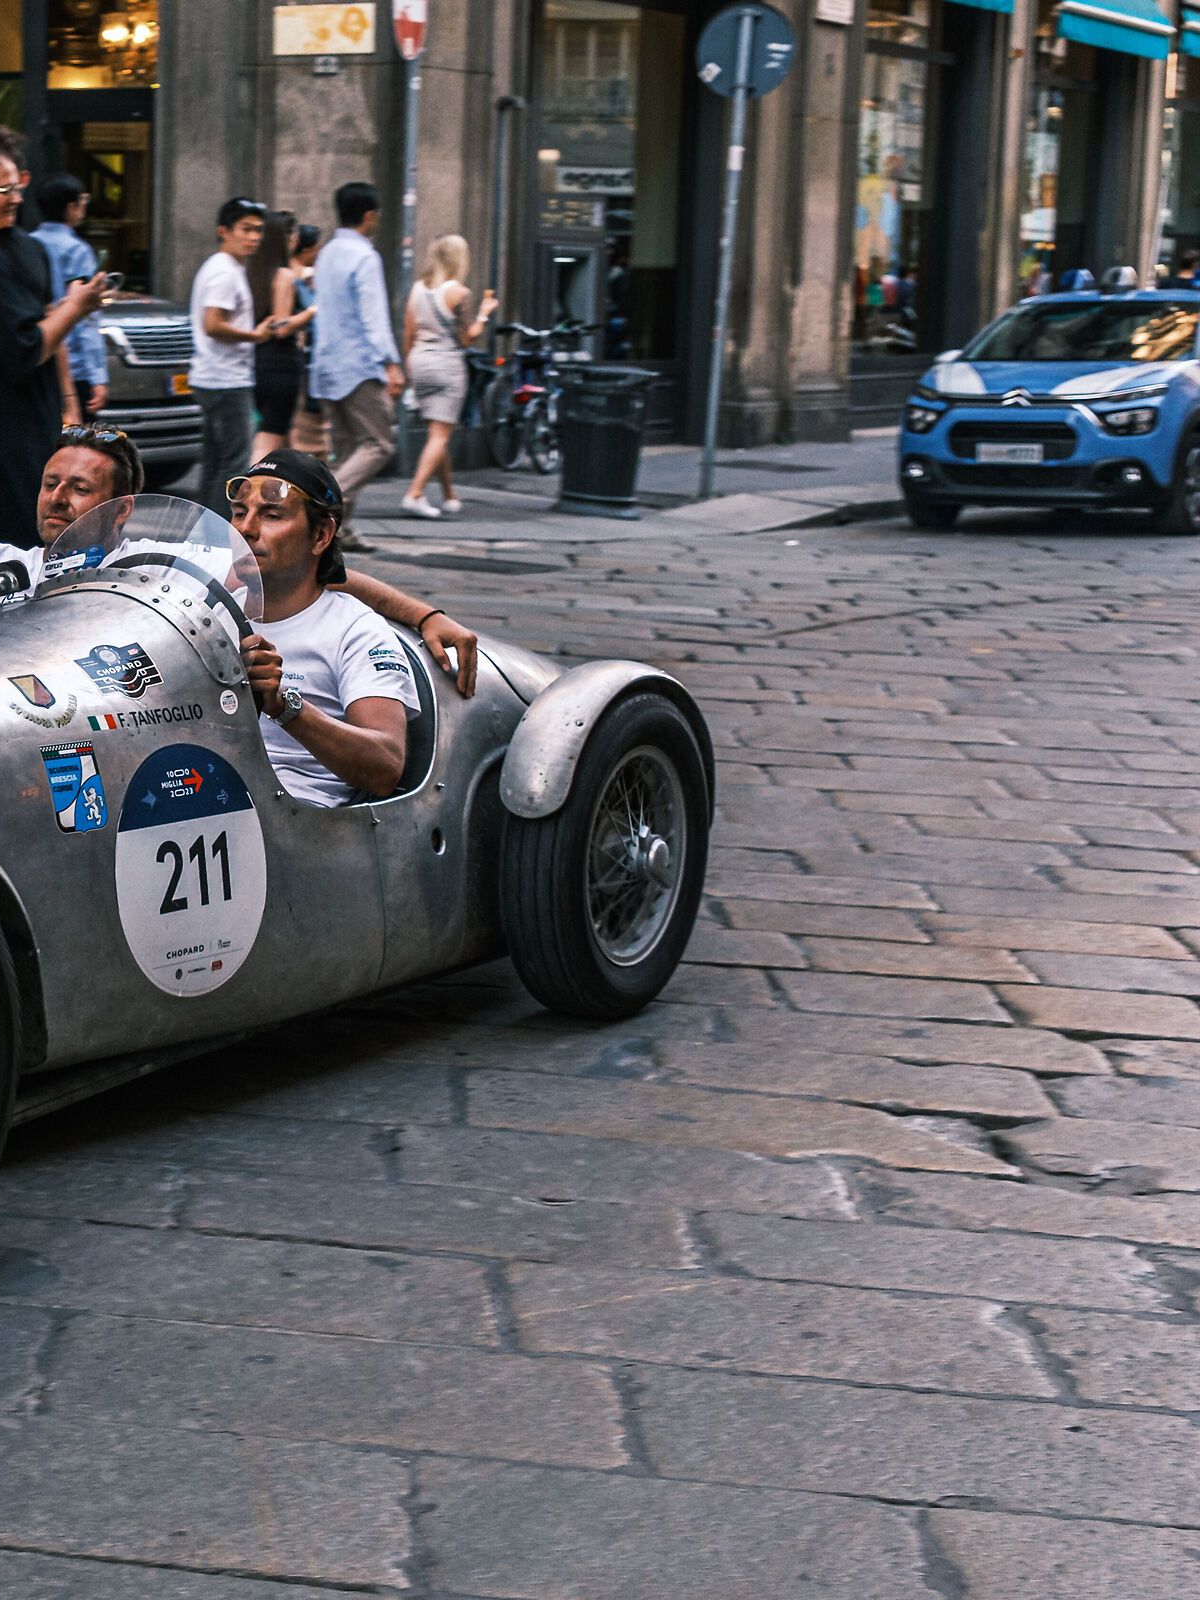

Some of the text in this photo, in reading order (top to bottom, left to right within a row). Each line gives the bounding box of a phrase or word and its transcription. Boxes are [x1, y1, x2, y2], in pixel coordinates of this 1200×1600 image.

[96, 660, 142, 677] CHOPARD
[116, 703, 204, 728] F. TANFOGLIO
[48, 764, 80, 775] SCUDERIA
[166, 768, 190, 778] 1000
[50, 774, 78, 784] BRESCIA
[161, 779, 183, 789] MIGLIA
[52, 784, 74, 793] CORSE
[170, 787, 194, 797] 2023
[155, 830, 233, 915] 211
[166, 944, 205, 960] CHOPARD
